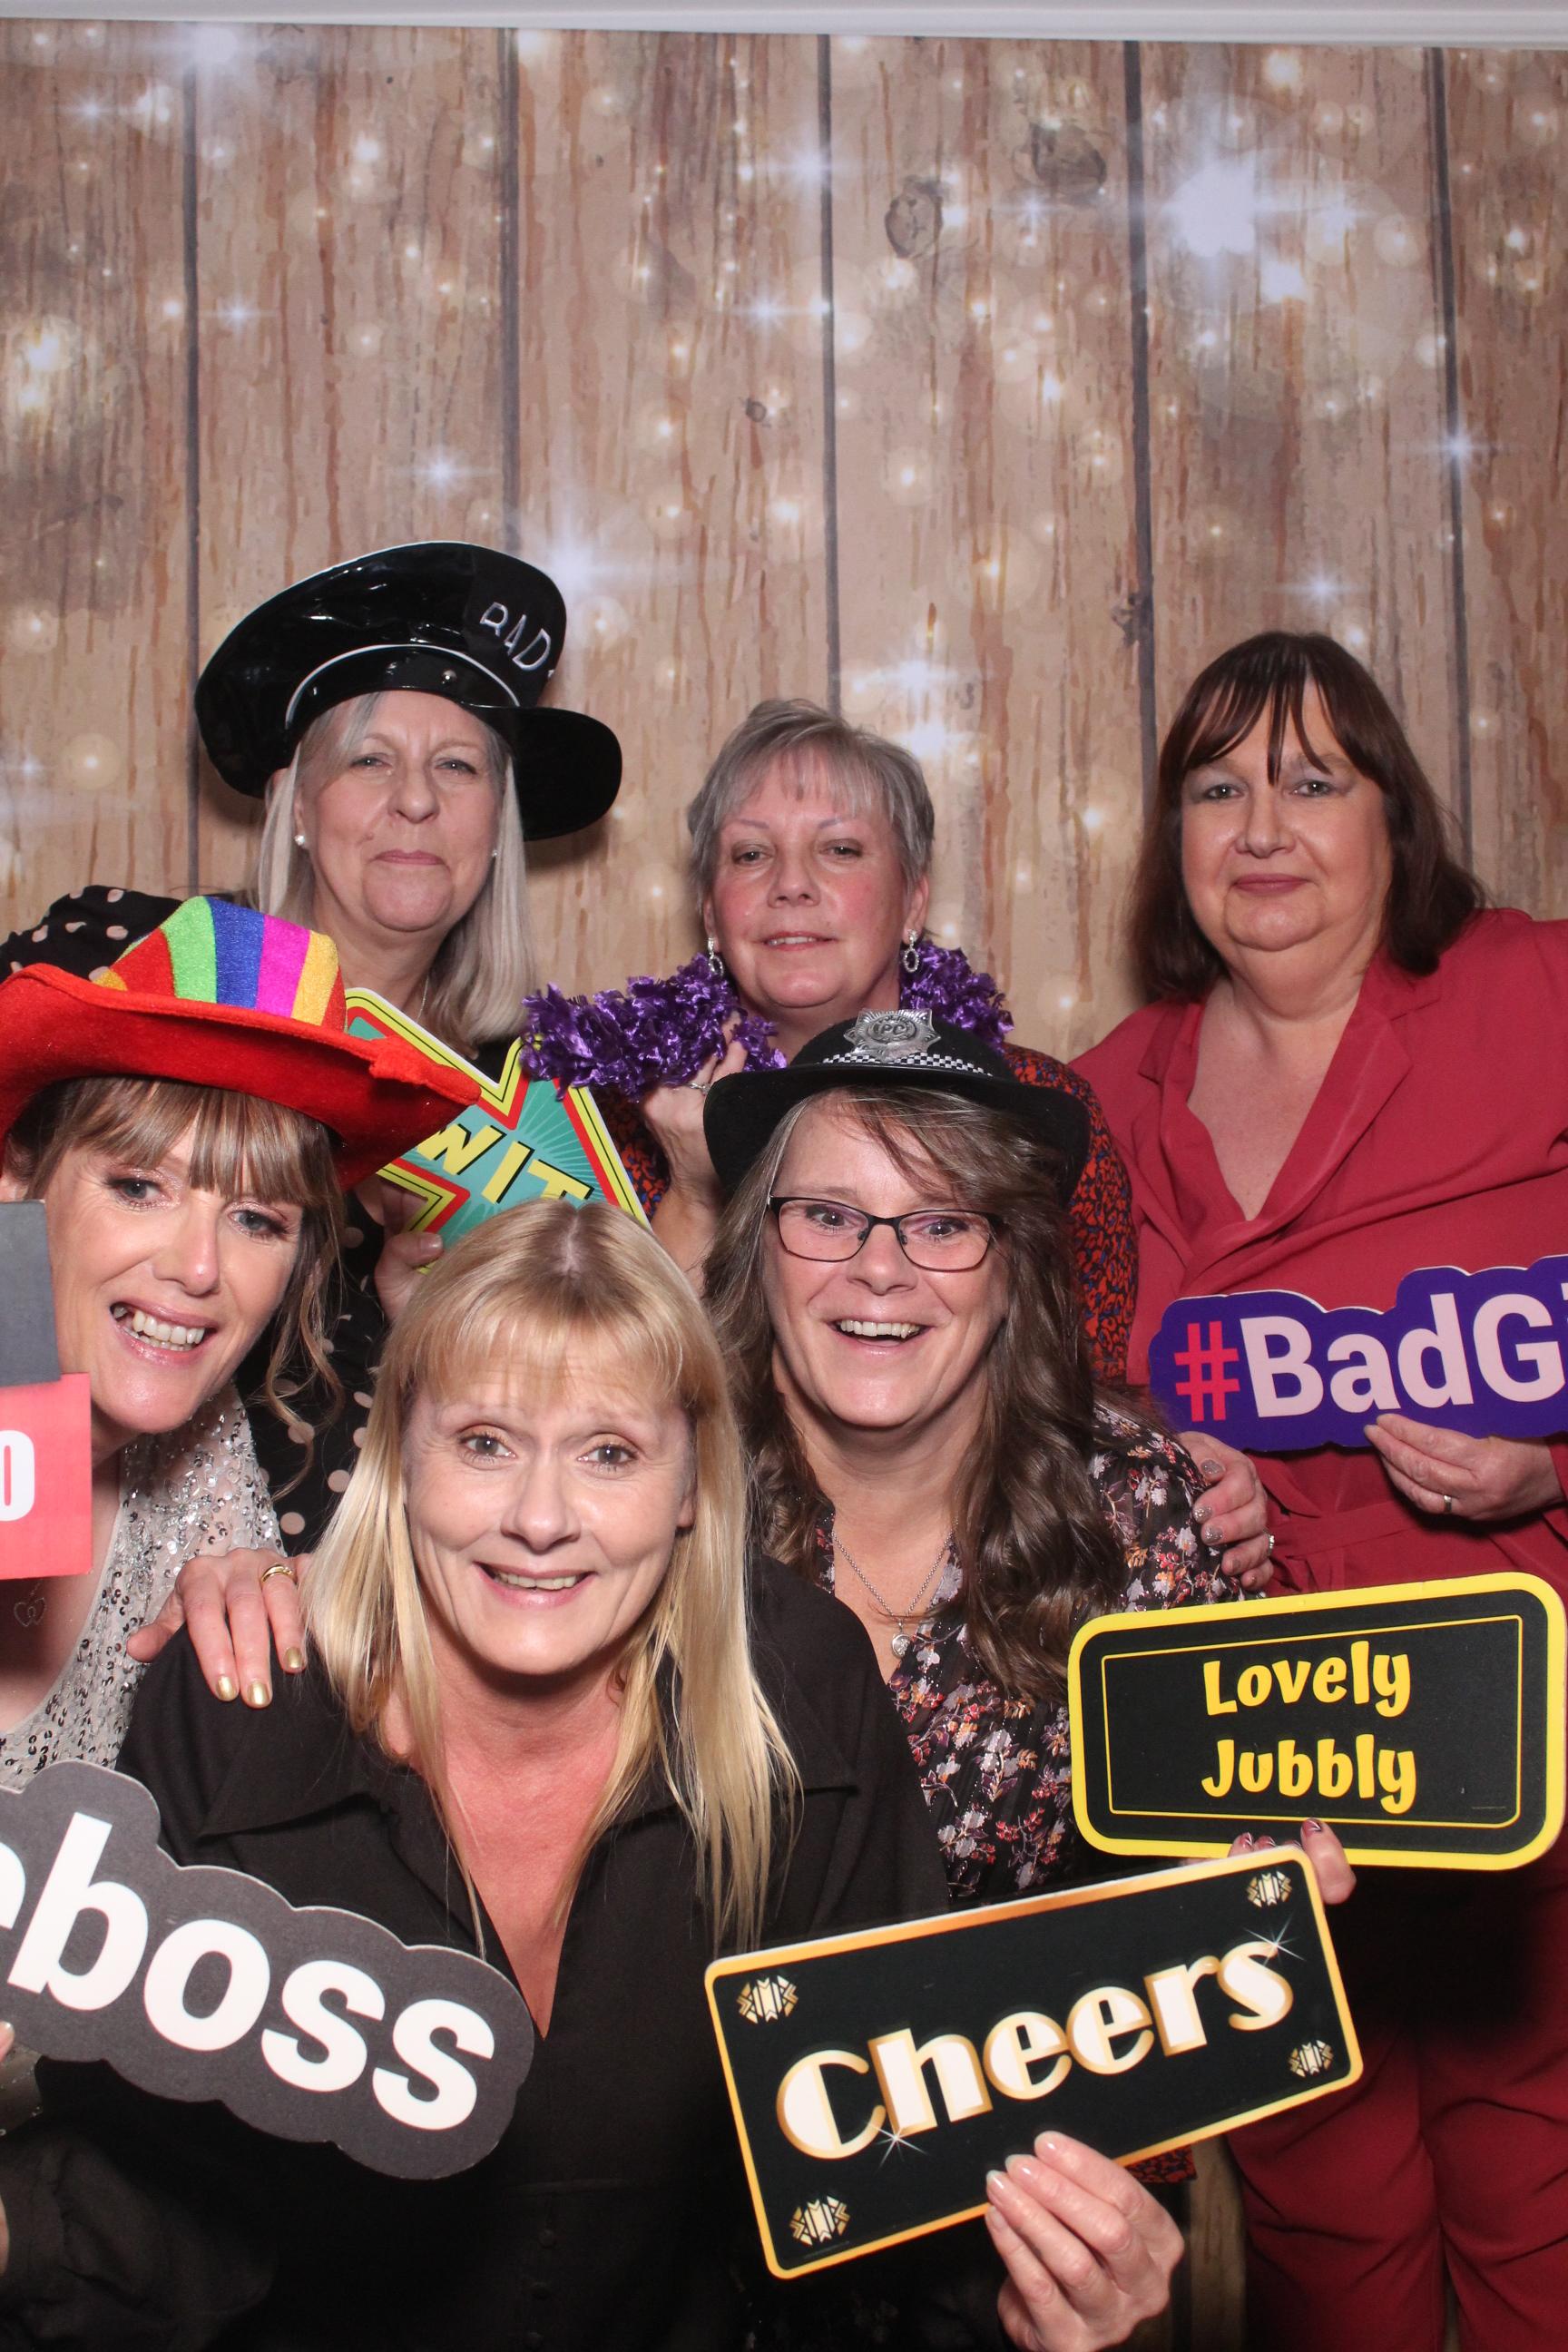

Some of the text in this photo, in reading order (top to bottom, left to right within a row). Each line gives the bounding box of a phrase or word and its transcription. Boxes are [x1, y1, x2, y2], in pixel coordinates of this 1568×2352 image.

[1173, 1283, 1568, 1422] #BadG
[1203, 1641, 1411, 1718] Lovely
[1200, 1734, 1417, 1814] Jubbly
[0, 1811, 495, 2131] boss
